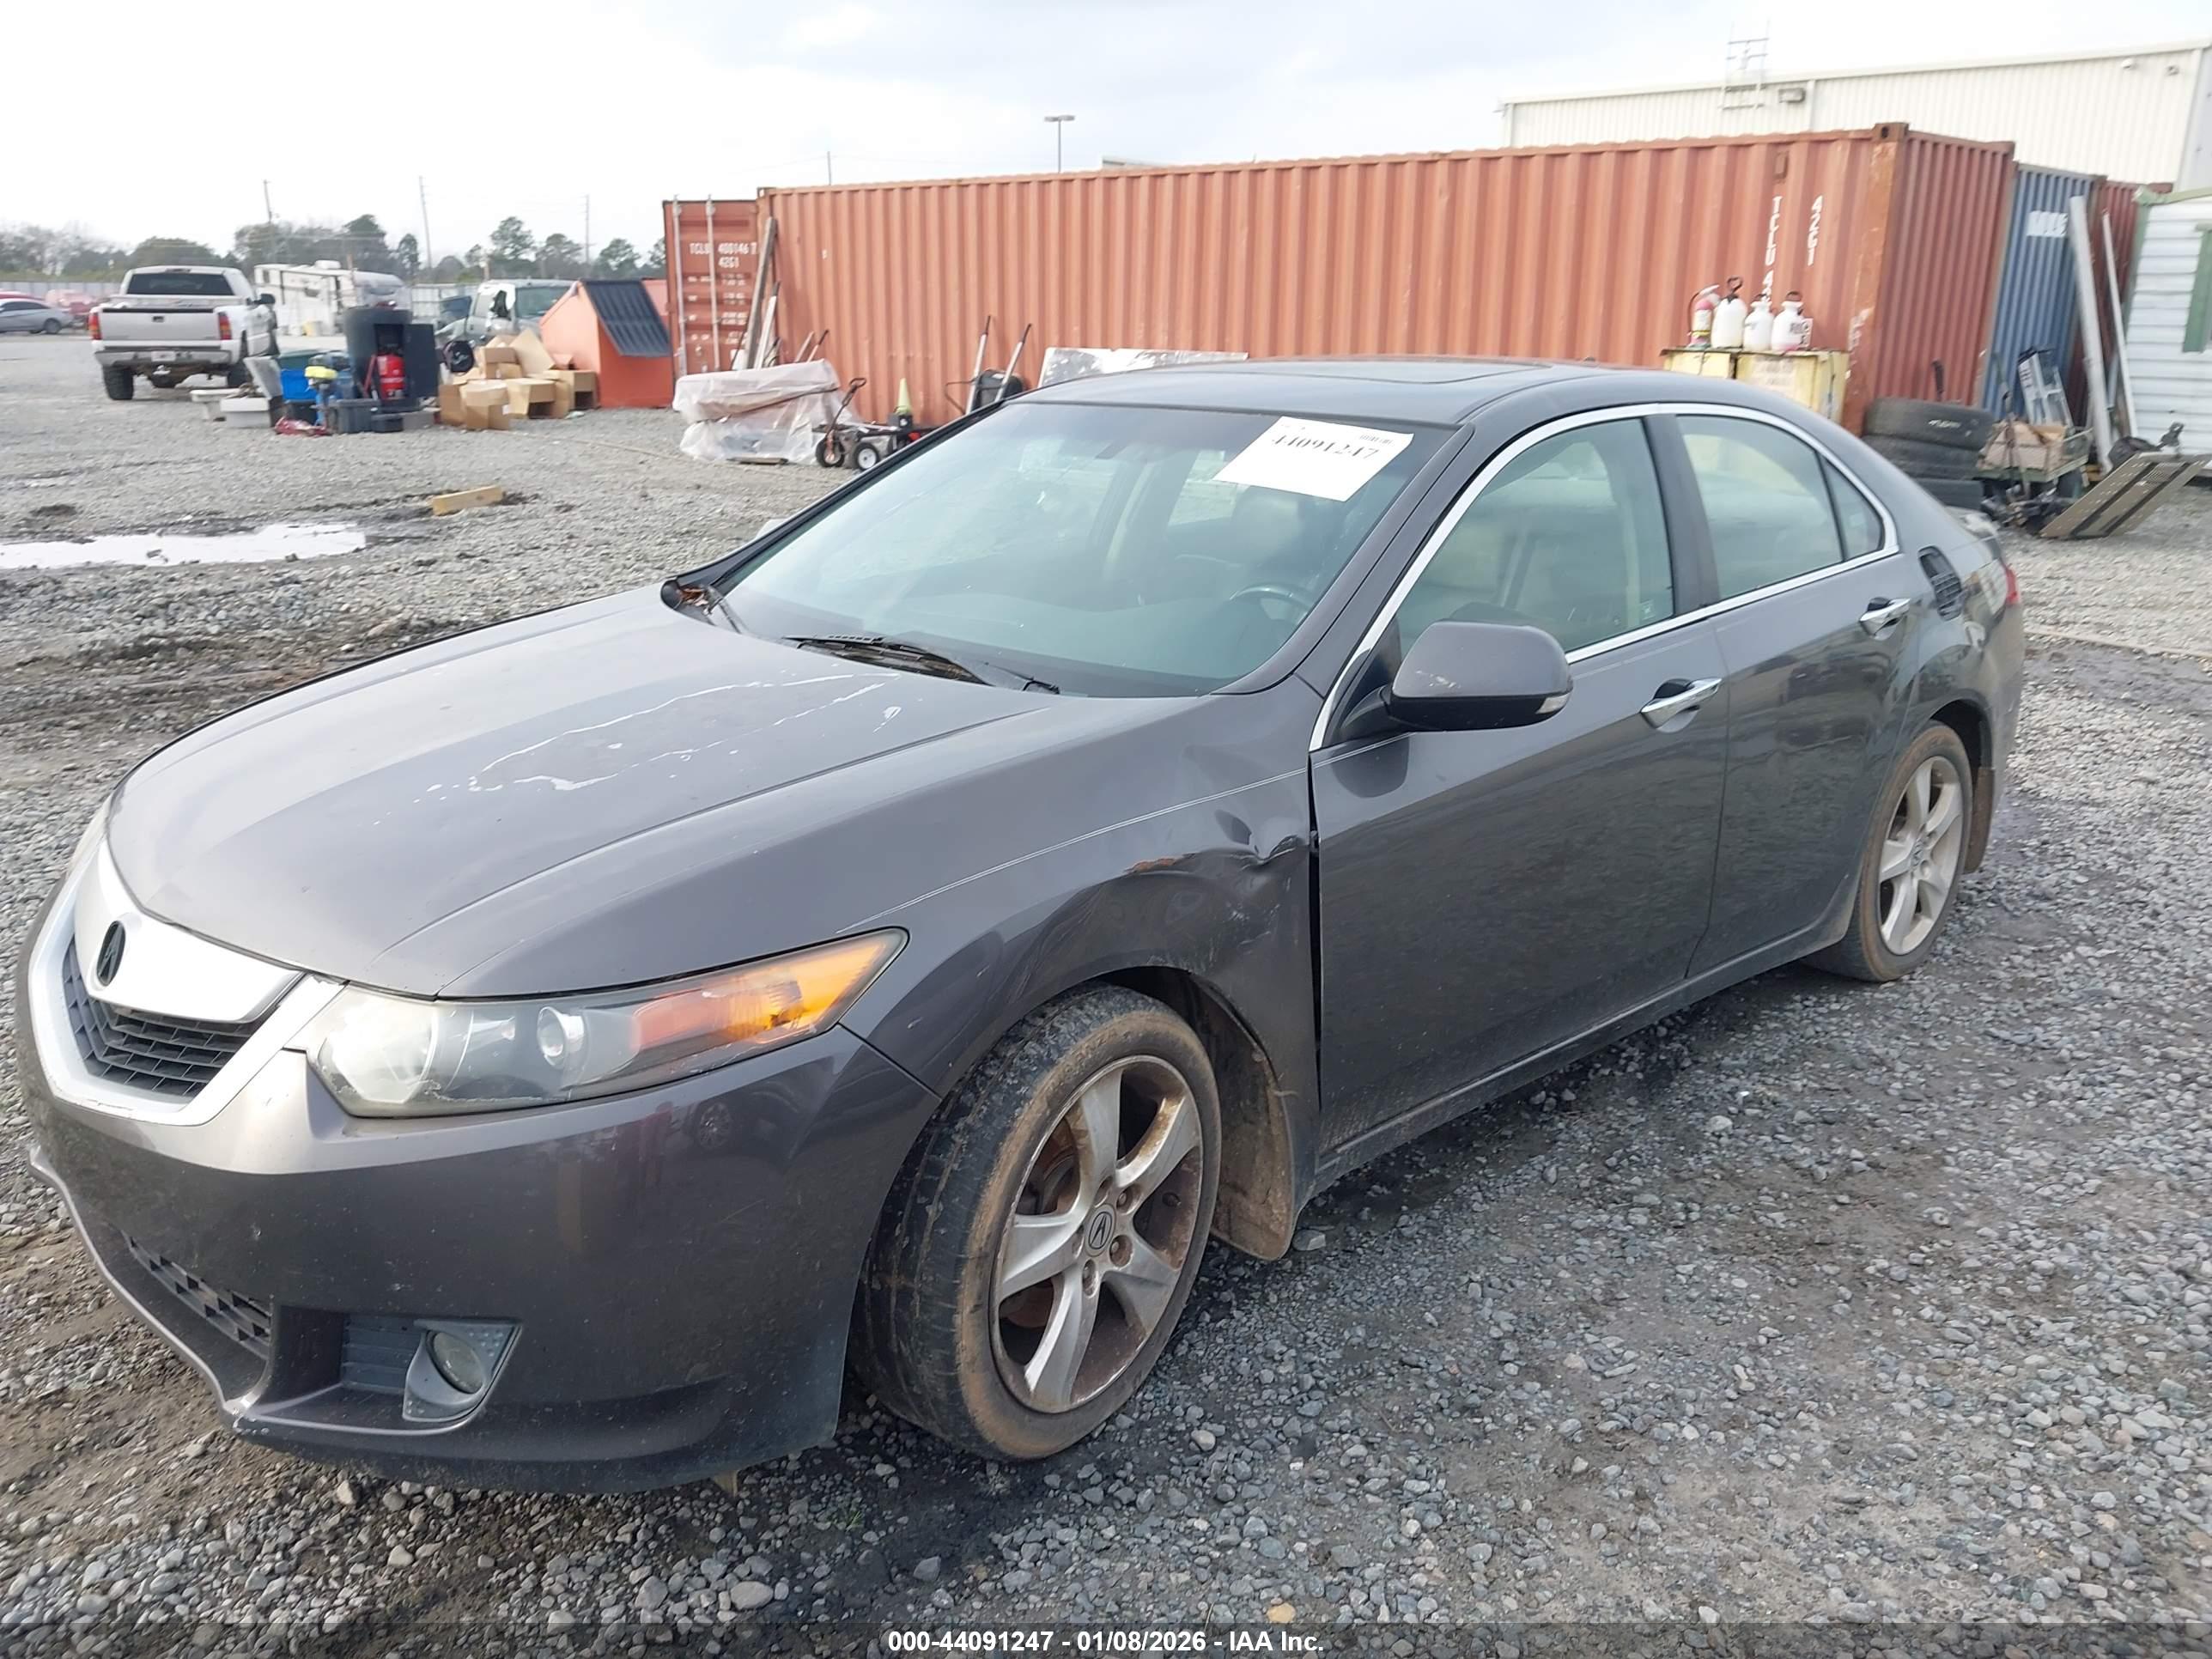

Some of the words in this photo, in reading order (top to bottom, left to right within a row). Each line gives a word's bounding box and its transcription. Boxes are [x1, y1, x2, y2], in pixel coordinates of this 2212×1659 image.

[1765, 195, 1783, 267] TCLU
[1807, 195, 1824, 267] 42G1
[1271, 434, 1380, 459] 44091247
